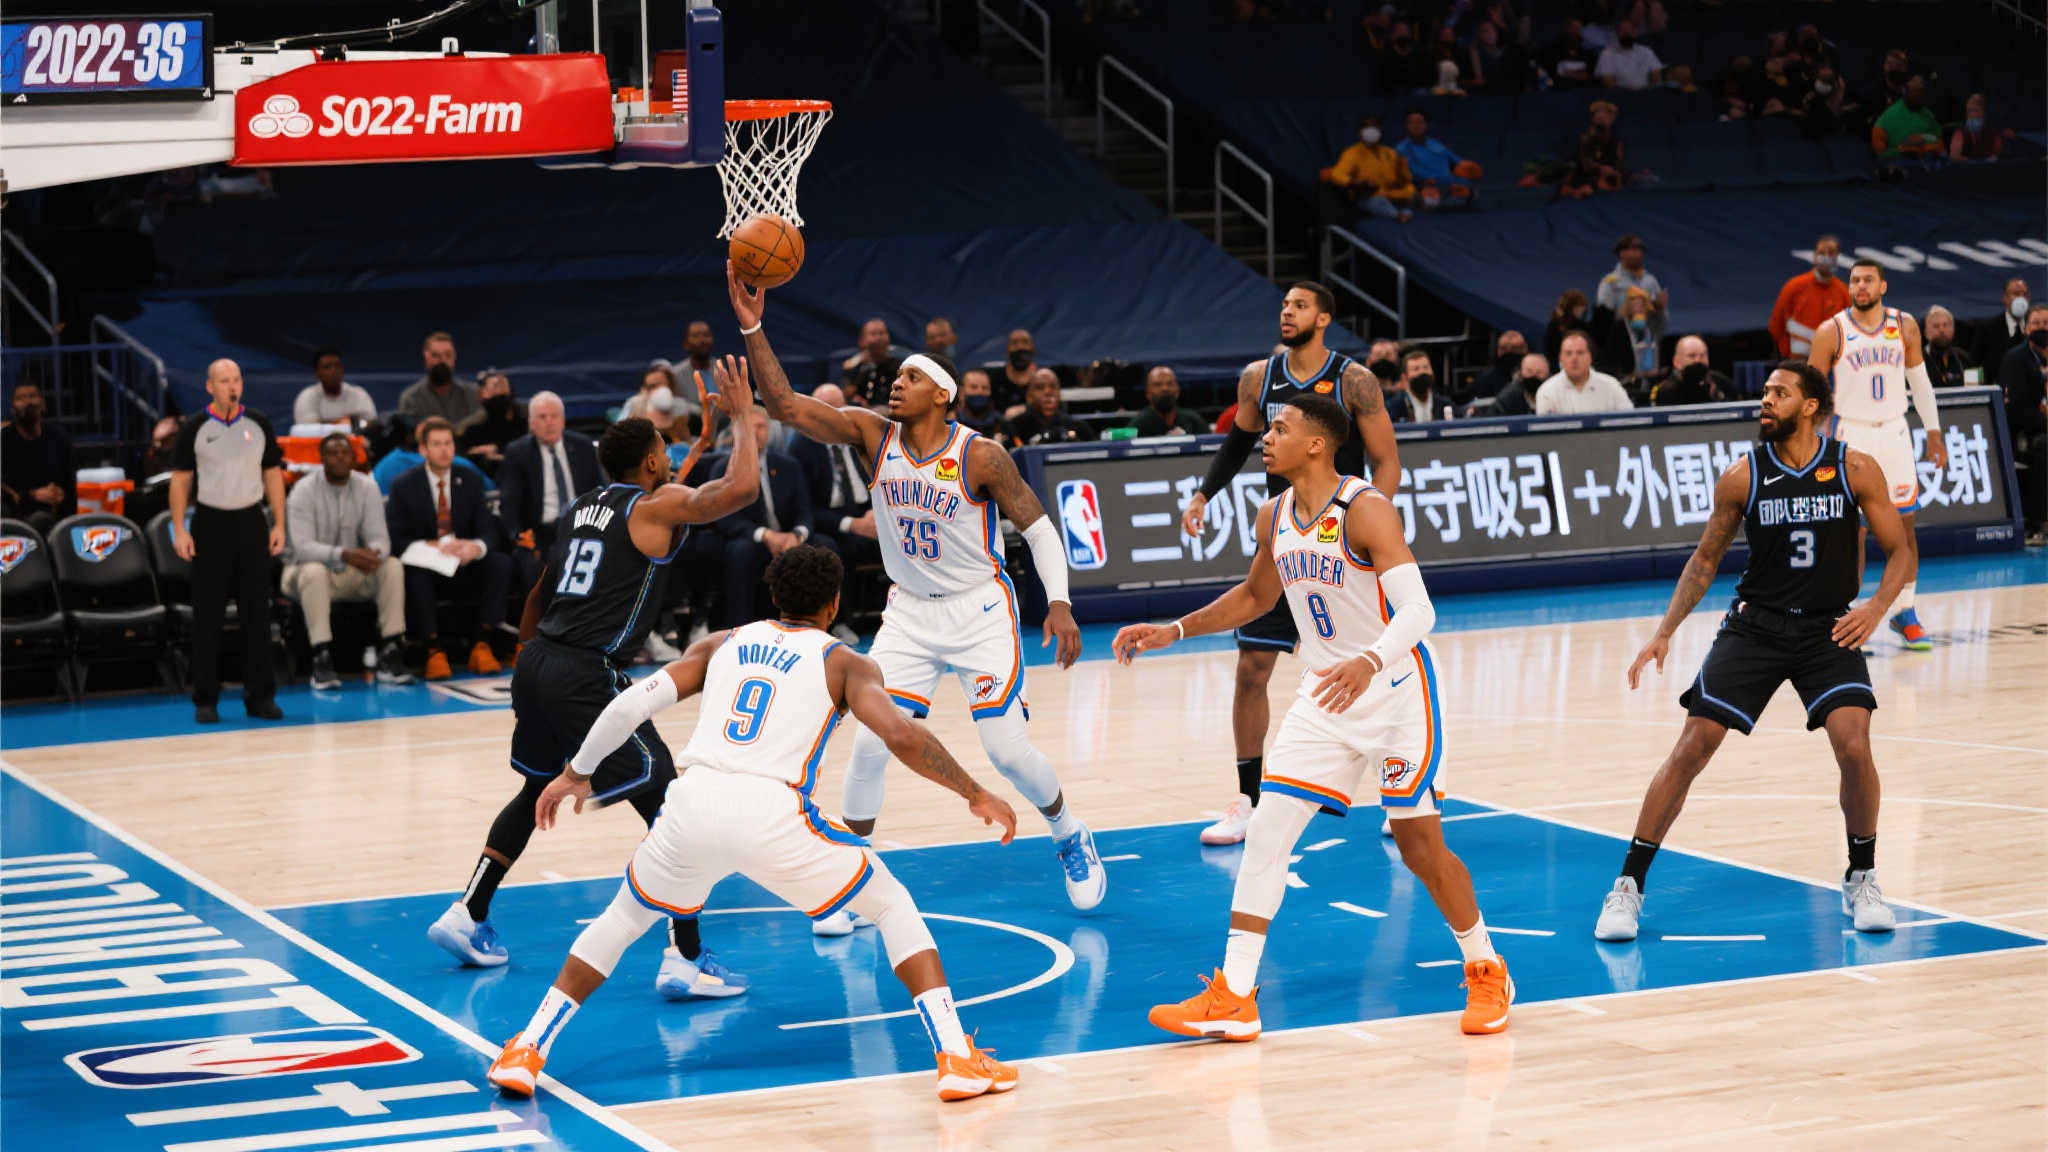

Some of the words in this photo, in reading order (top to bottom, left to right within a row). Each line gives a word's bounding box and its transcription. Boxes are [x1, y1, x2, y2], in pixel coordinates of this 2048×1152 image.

[880, 479, 961, 521] THUNDER
[556, 538, 604, 596] 13
[1276, 549, 1345, 589] THUNDER
[1789, 529, 1815, 569] 3
[723, 676, 777, 746] 9
